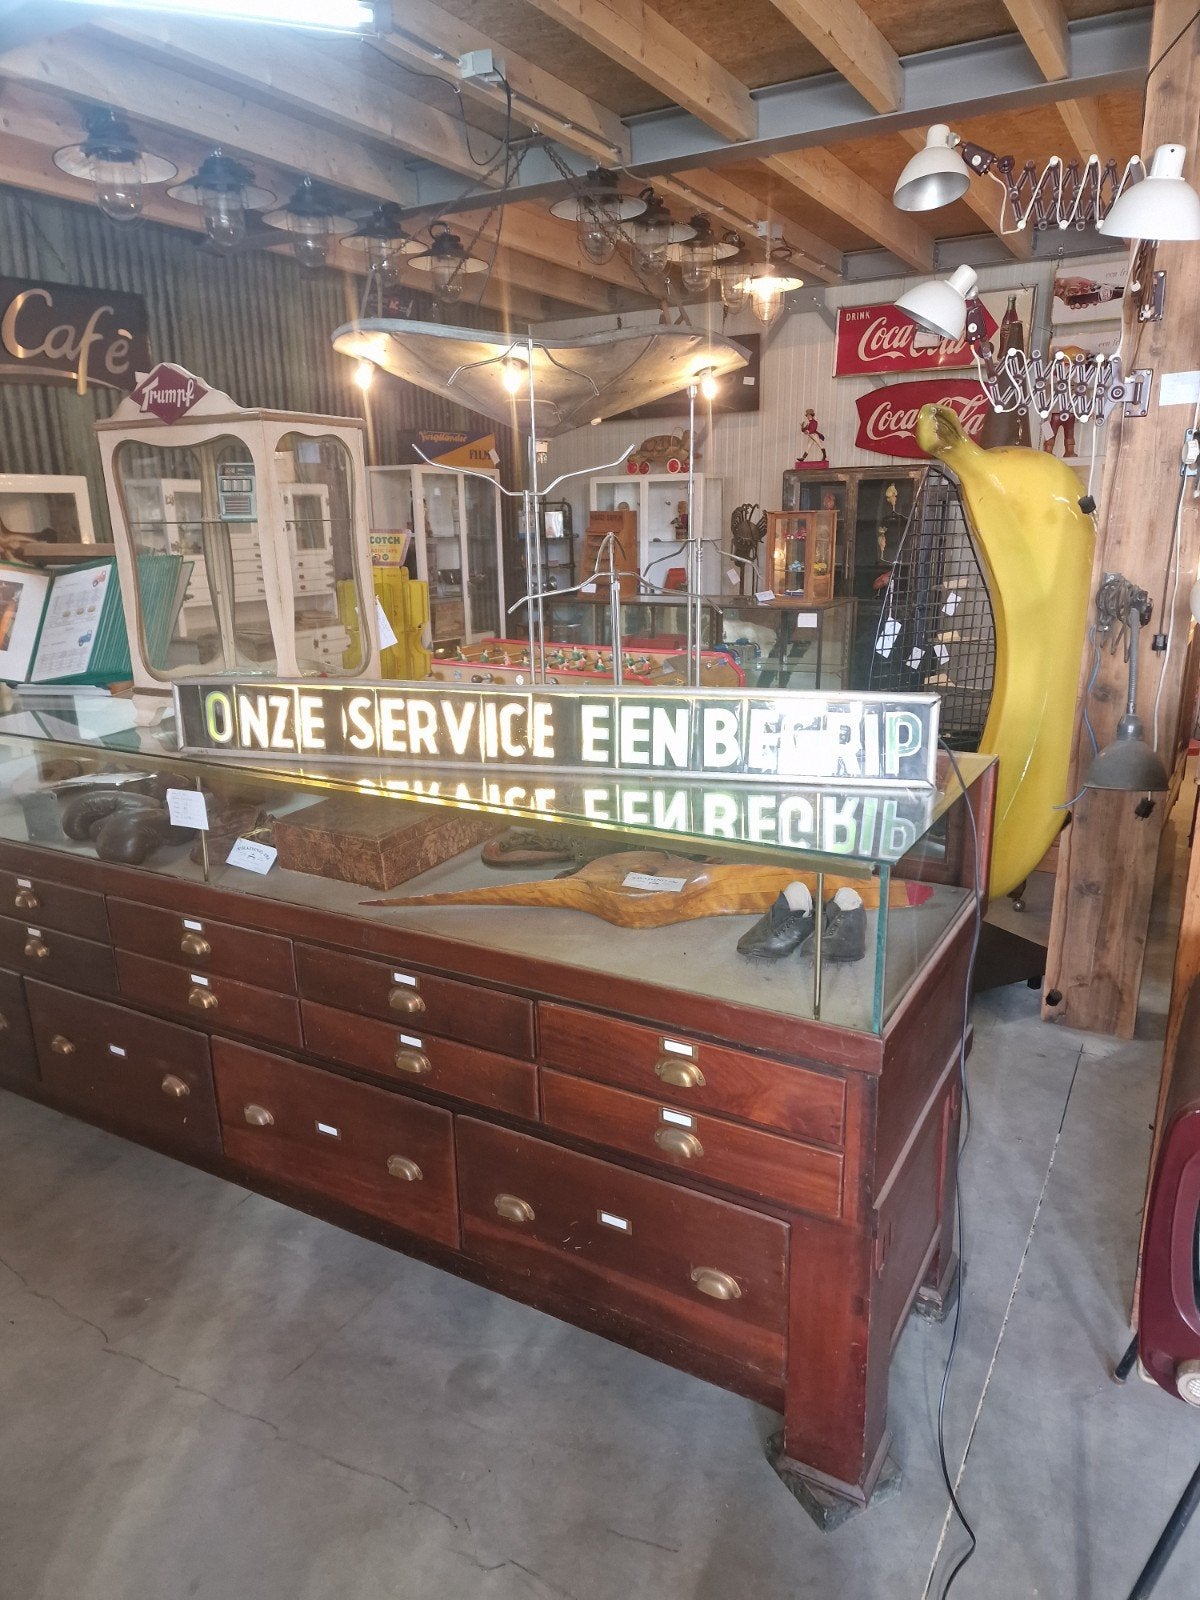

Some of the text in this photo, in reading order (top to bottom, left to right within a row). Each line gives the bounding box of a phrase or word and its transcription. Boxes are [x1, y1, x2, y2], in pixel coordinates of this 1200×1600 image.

[846, 310, 871, 322] DRINK
[140, 376, 195, 412] Trumpf
[369, 536, 400, 545] COTCH
[205, 691, 325, 749] ONZE
[349, 697, 555, 759] SERVICE
